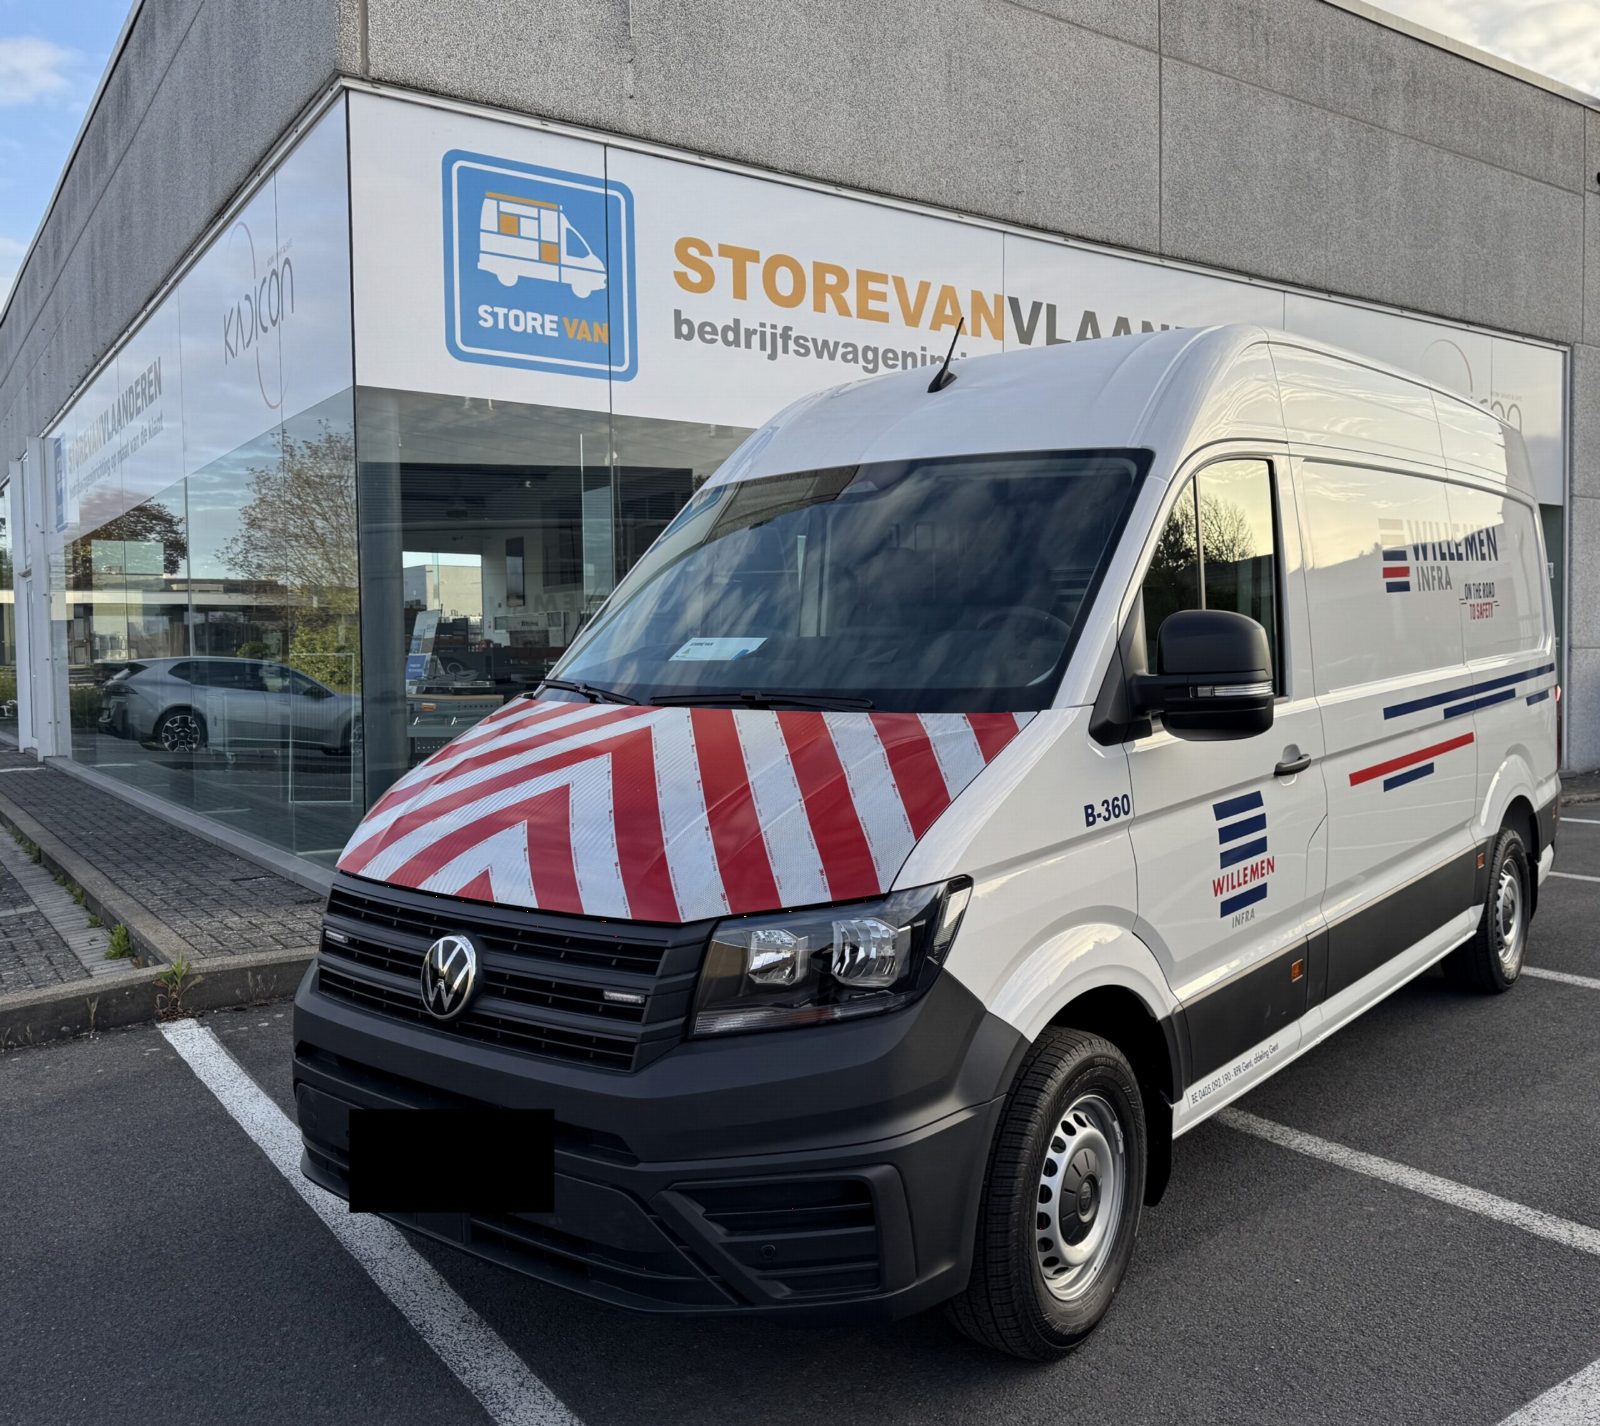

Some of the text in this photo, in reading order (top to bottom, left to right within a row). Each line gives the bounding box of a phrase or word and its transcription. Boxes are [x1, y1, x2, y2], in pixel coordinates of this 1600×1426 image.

[478, 304, 609, 345] STORE VAN
[1407, 519, 1498, 561] WILLEMEN
[1416, 565, 1452, 591] INFRA
[1464, 581, 1495, 600] ON THE ROAD
[1469, 601, 1494, 620] TO SAFETY
[1083, 793, 1131, 828] B-360
[1212, 855, 1275, 898] WILLEMEN
[1231, 907, 1256, 929] INFRA
[1191, 1093, 1199, 1105] BE
